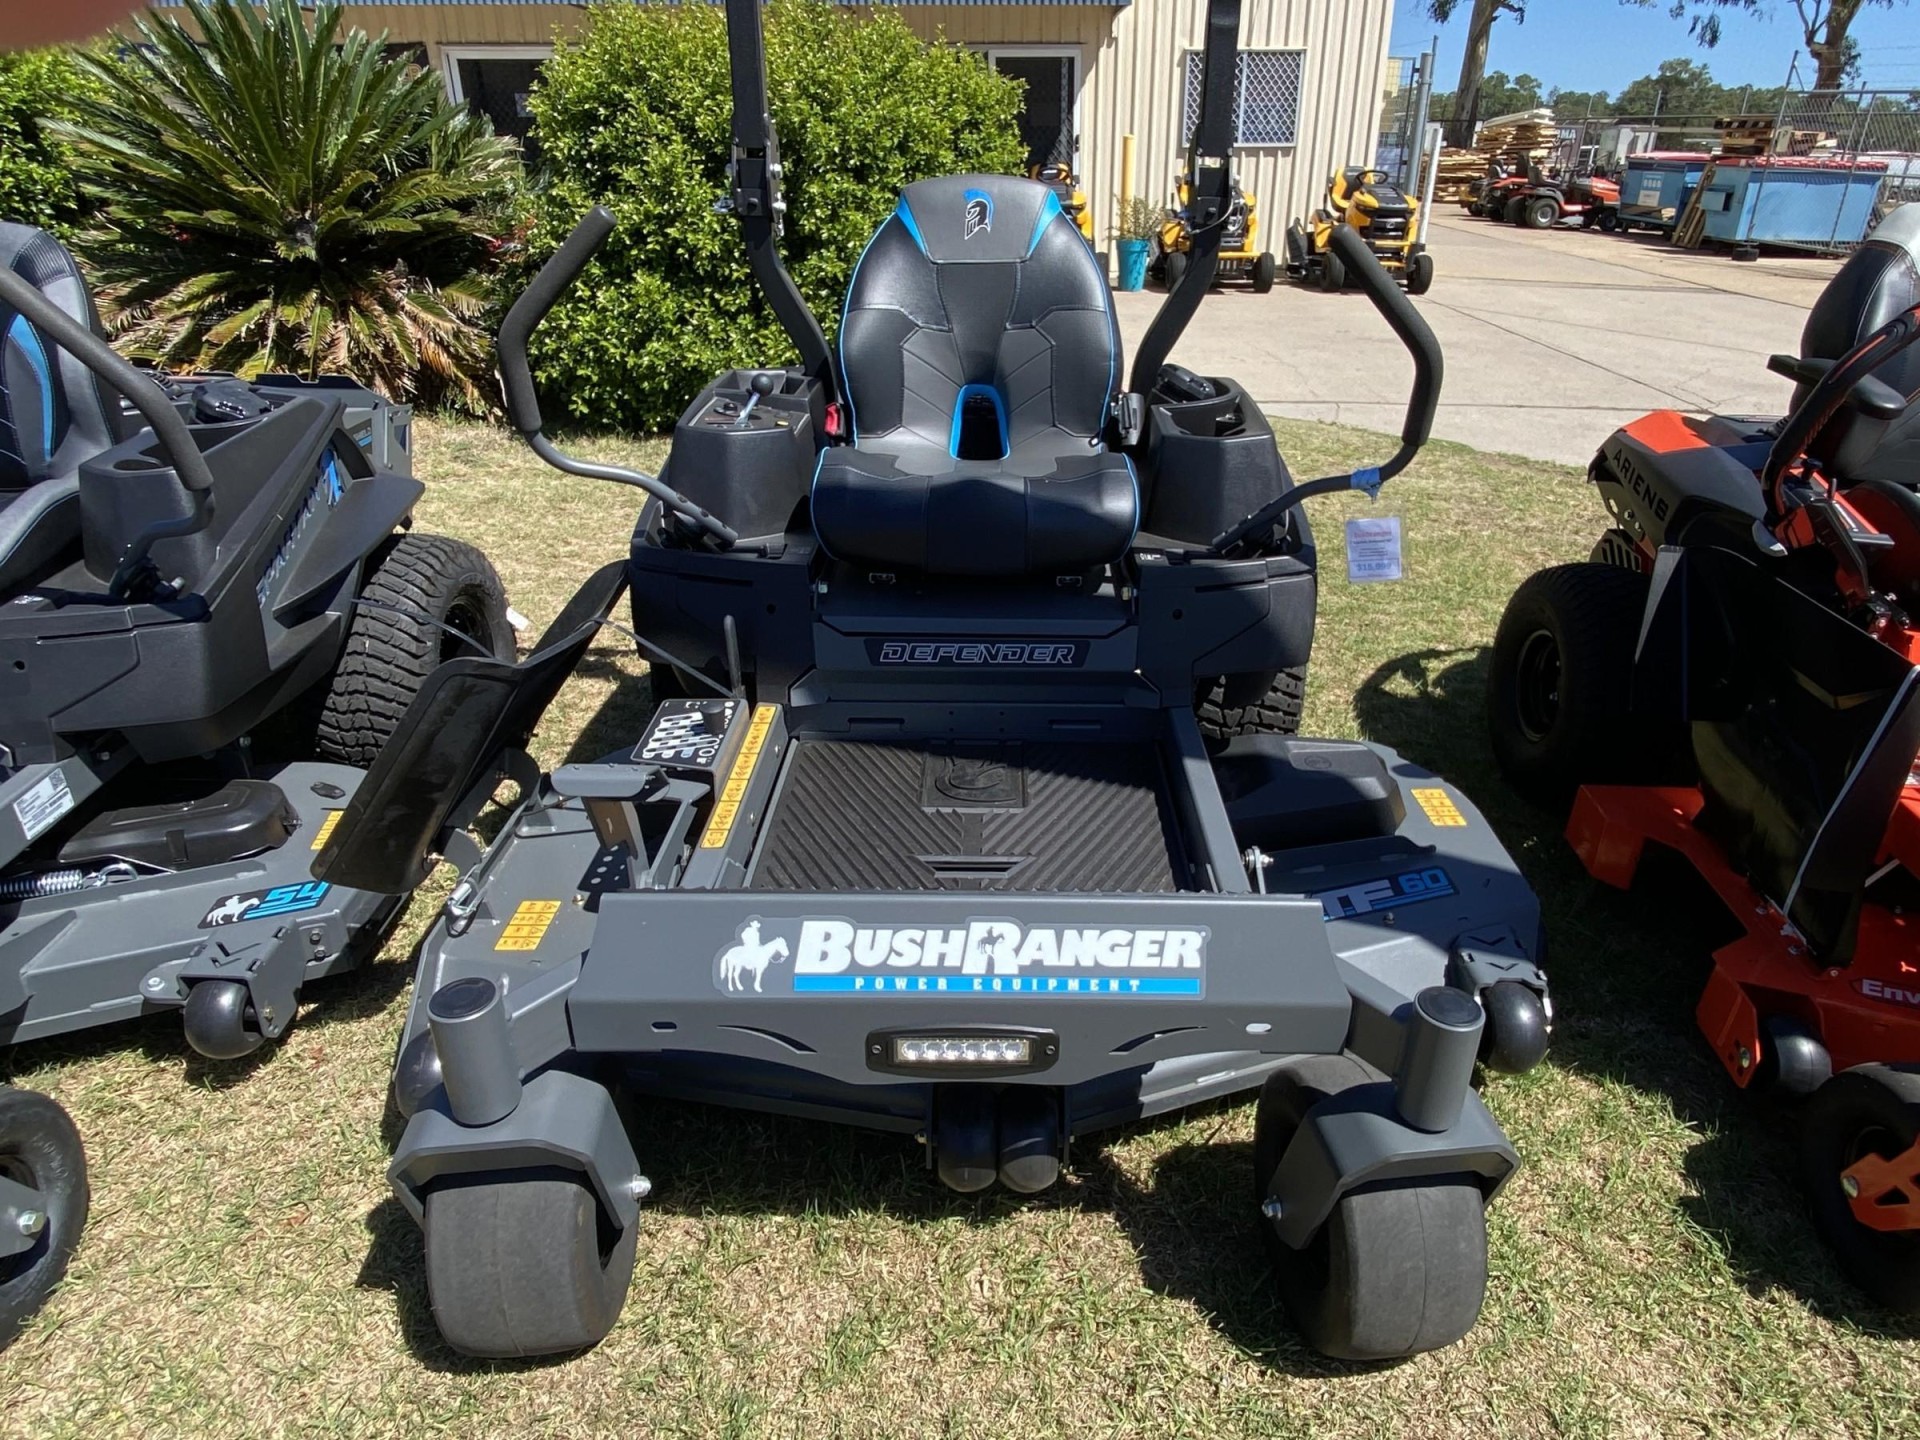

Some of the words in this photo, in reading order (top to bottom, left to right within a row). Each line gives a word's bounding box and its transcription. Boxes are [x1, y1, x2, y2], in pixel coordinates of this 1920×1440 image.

[1613, 448, 1670, 521] ARIENS
[879, 642, 1075, 664] DEFENDER
[1398, 868, 1449, 894] 60
[259, 881, 330, 908] 54
[855, 978, 949, 991] POWER
[973, 978, 1142, 994] EQUIPMENT
